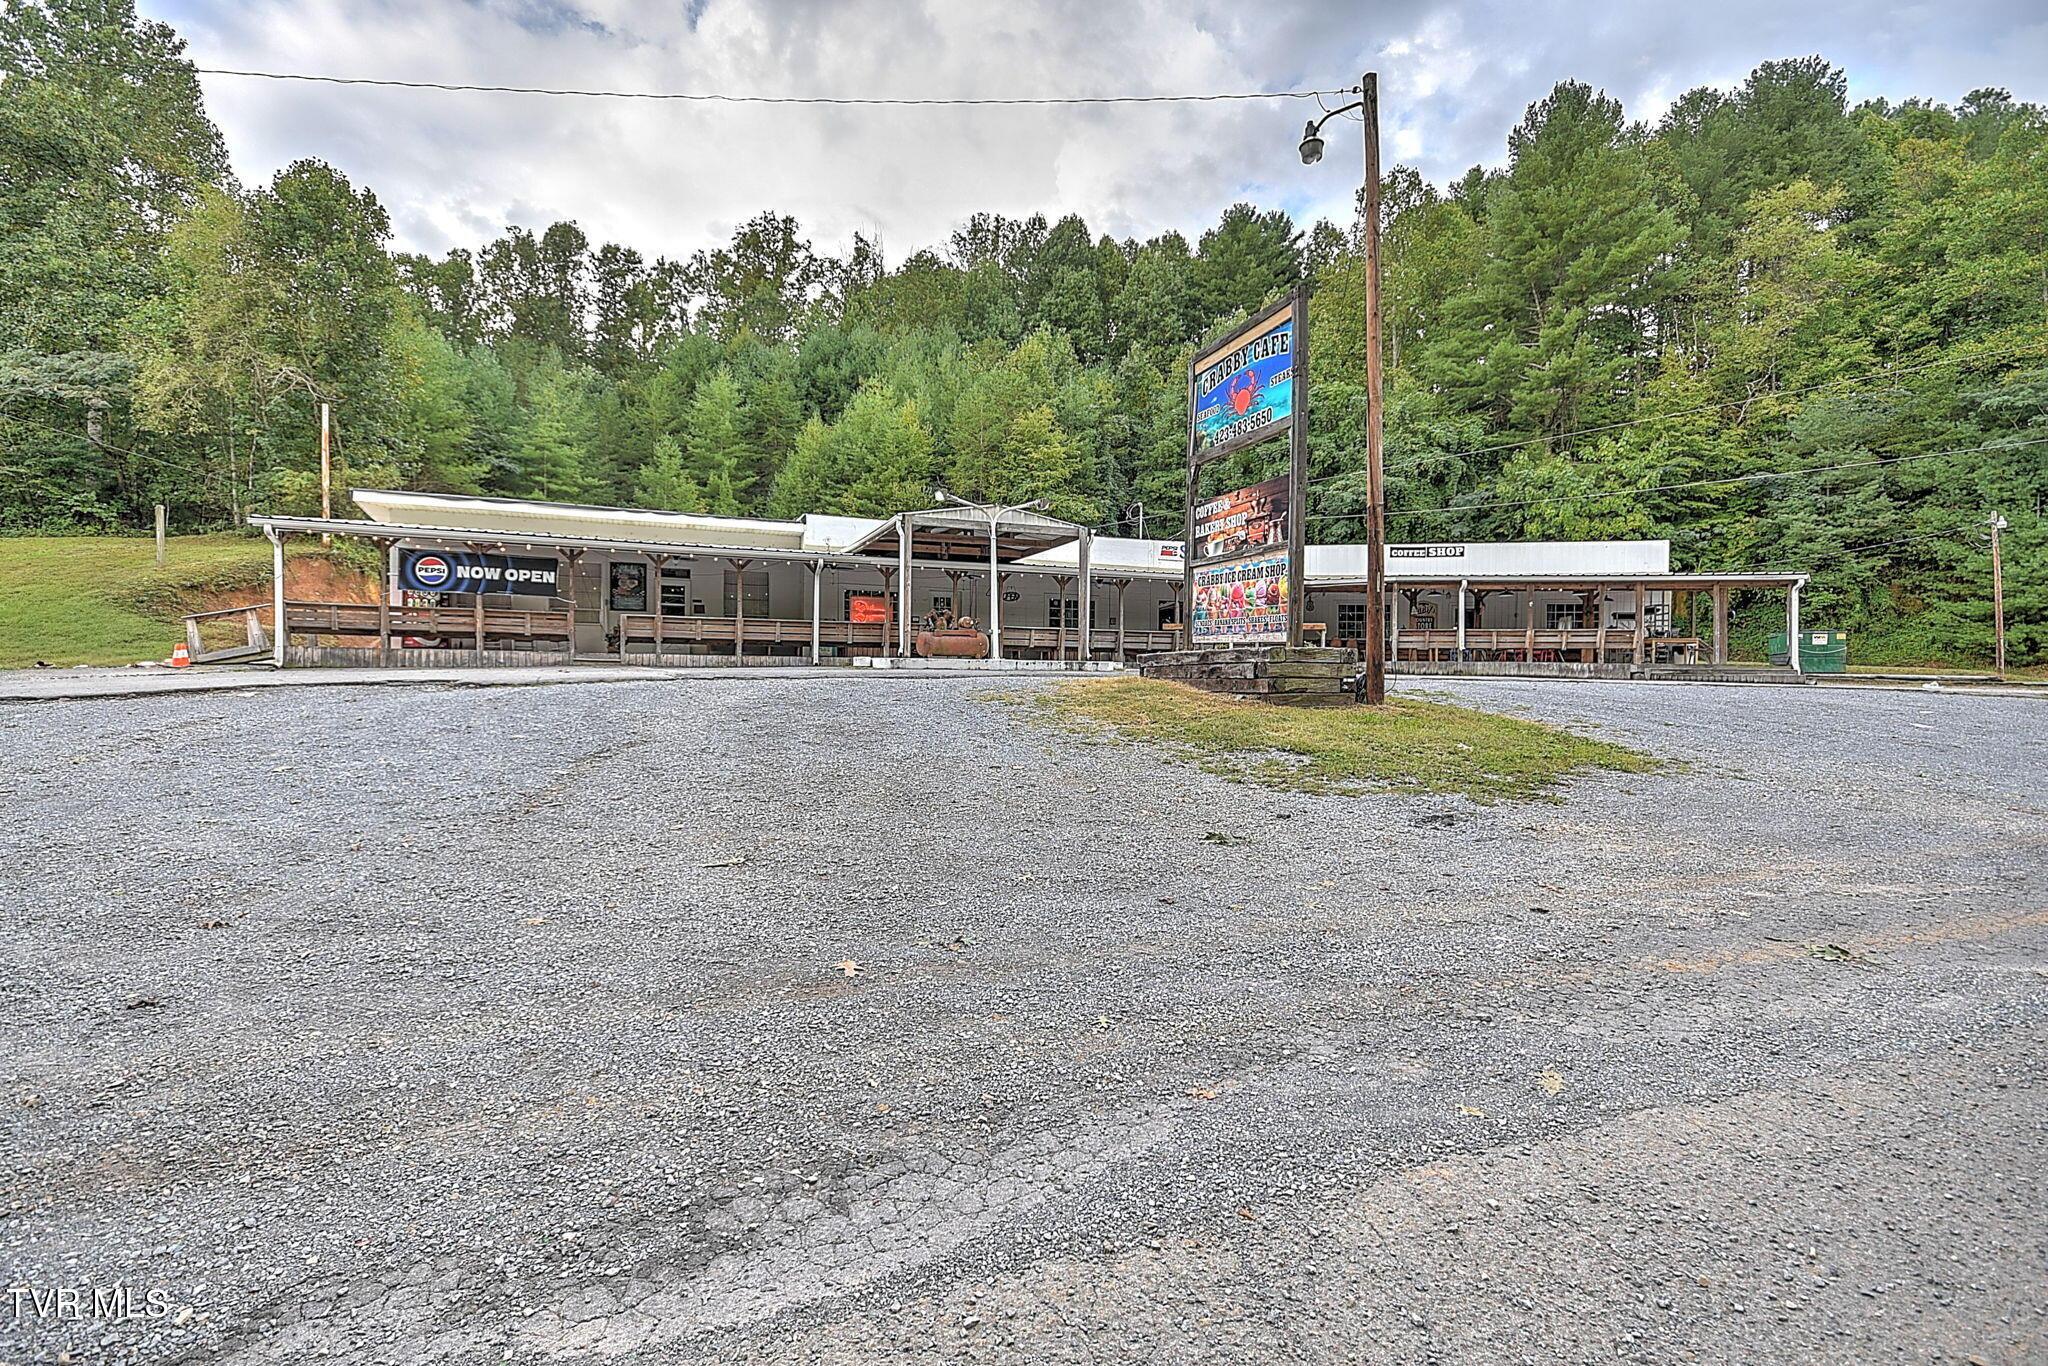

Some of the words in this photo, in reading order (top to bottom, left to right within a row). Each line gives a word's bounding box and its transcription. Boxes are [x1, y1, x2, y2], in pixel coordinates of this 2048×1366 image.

[1202, 343, 1249, 396] CRABBY
[1253, 333, 1289, 359] CAFE
[1195, 499, 1223, 520] COFFEE
[1195, 518, 1225, 538] BAKERY
[1226, 512, 1248, 528] SHOP
[1391, 549, 1426, 557] COFFEE
[1428, 547, 1464, 557] SHOP
[417, 566, 446, 575] PEPSI
[457, 566, 502, 580] NOW
[504, 569, 556, 584] OPEN
[1197, 573, 1224, 587] CRABBY
[1224, 570, 1237, 584] ICE
[1237, 566, 1264, 582] CREAM
[1265, 563, 1287, 578] SHOP
[1269, 614, 1288, 623] FLOATS
